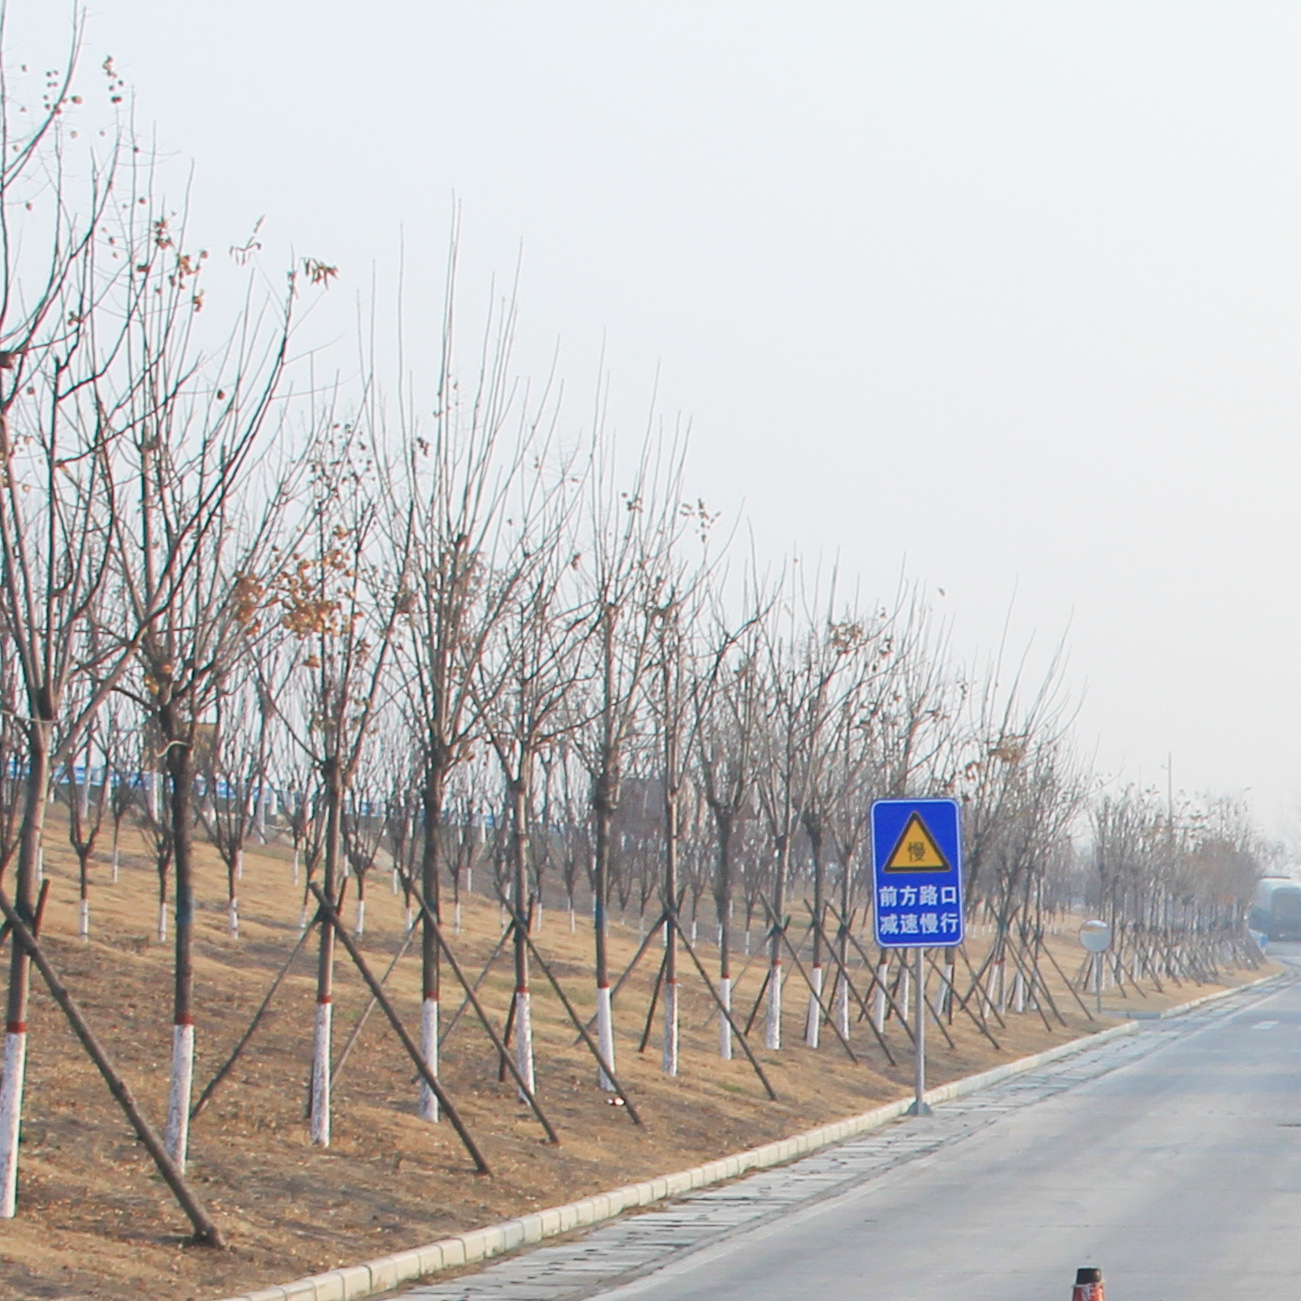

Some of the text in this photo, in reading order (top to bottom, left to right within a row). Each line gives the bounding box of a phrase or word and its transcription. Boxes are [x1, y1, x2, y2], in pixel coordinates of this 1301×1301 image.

[879, 885, 957, 908] 前方路口
[880, 913, 958, 935] 减速慢行
